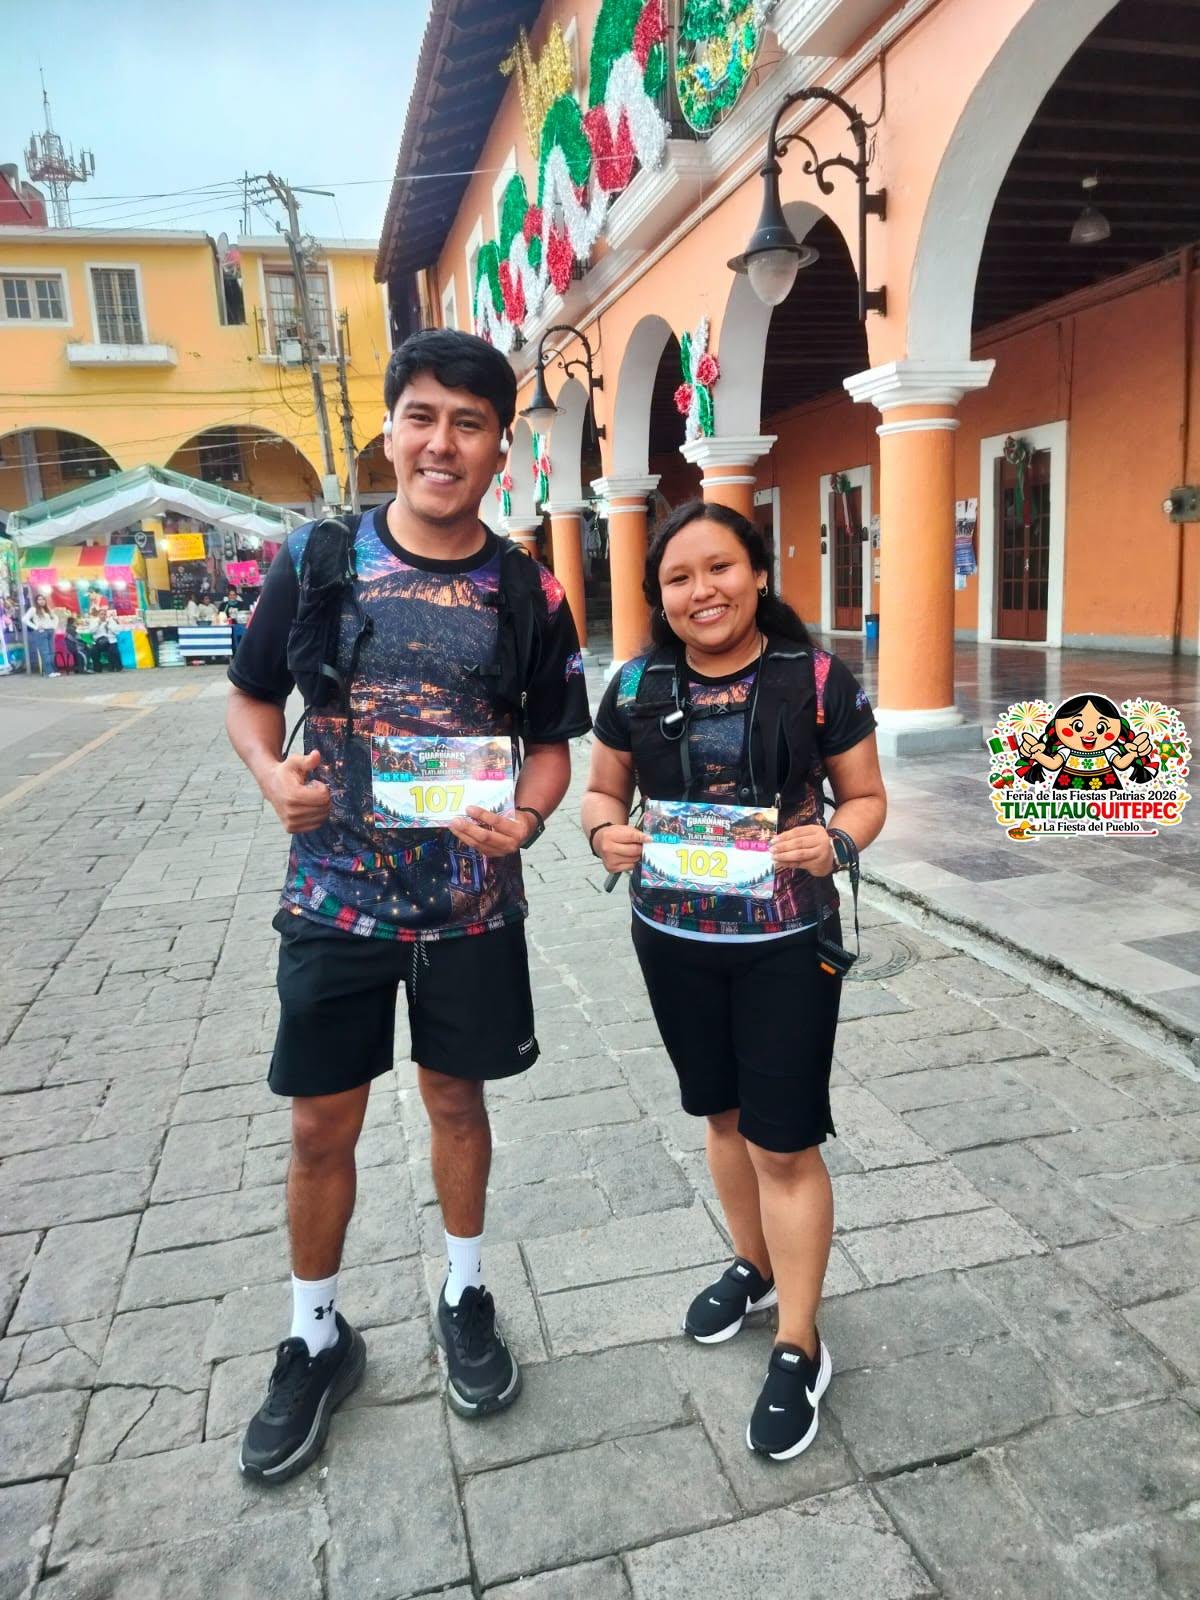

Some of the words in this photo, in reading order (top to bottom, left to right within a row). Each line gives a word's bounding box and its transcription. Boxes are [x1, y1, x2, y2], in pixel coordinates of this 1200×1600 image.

[419, 751, 465, 763] GUARDIANES
[383, 772, 391, 781] 5
[392, 773, 409, 781] KM
[488, 771, 504, 780] KM
[409, 785, 465, 813] 107
[687, 816, 731, 830] GUARDIANES
[653, 833, 660, 842] 5
[661, 834, 677, 844] KM
[738, 840, 750, 850] 10
[676, 849, 728, 878] 102
